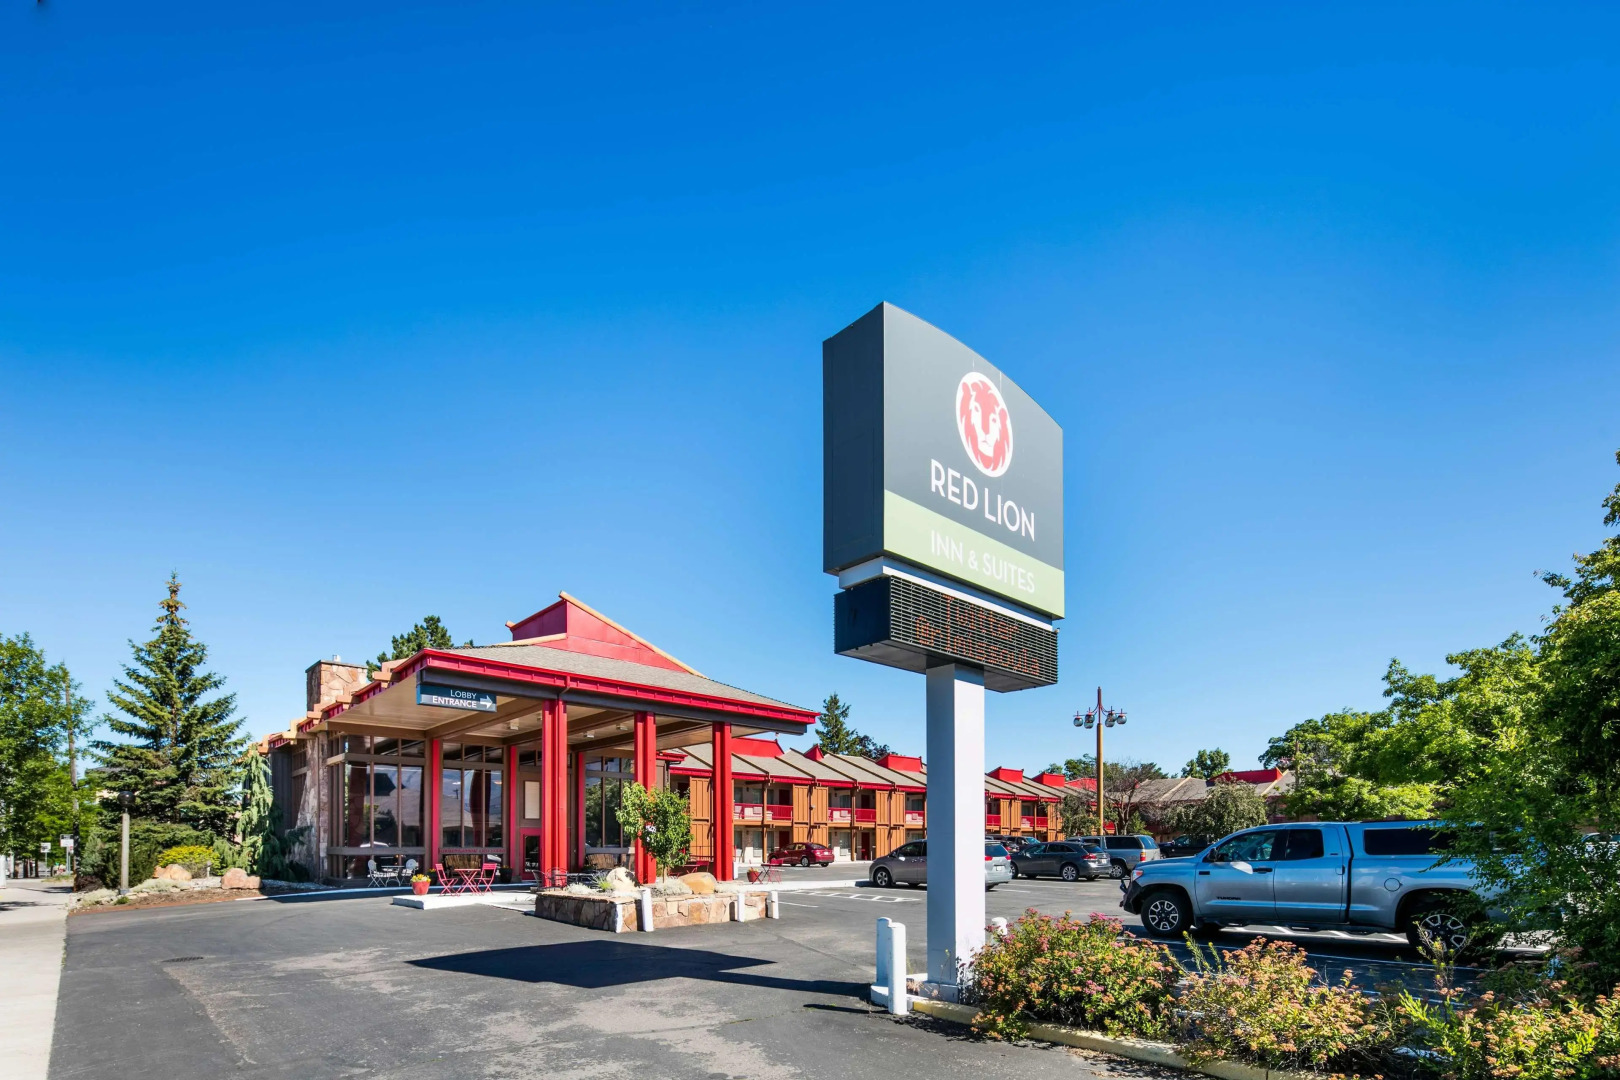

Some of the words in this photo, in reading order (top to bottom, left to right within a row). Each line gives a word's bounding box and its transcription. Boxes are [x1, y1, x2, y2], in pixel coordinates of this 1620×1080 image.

[931, 458, 979, 511] RED
[984, 487, 1035, 541] LION
[931, 530, 963, 566] INN
[968, 550, 979, 571] &
[983, 552, 1036, 593] SUITES
[943, 594, 1019, 642] Twitter
[432, 696, 477, 708] ENTRANCE
[450, 689, 477, 699] LOBBY
